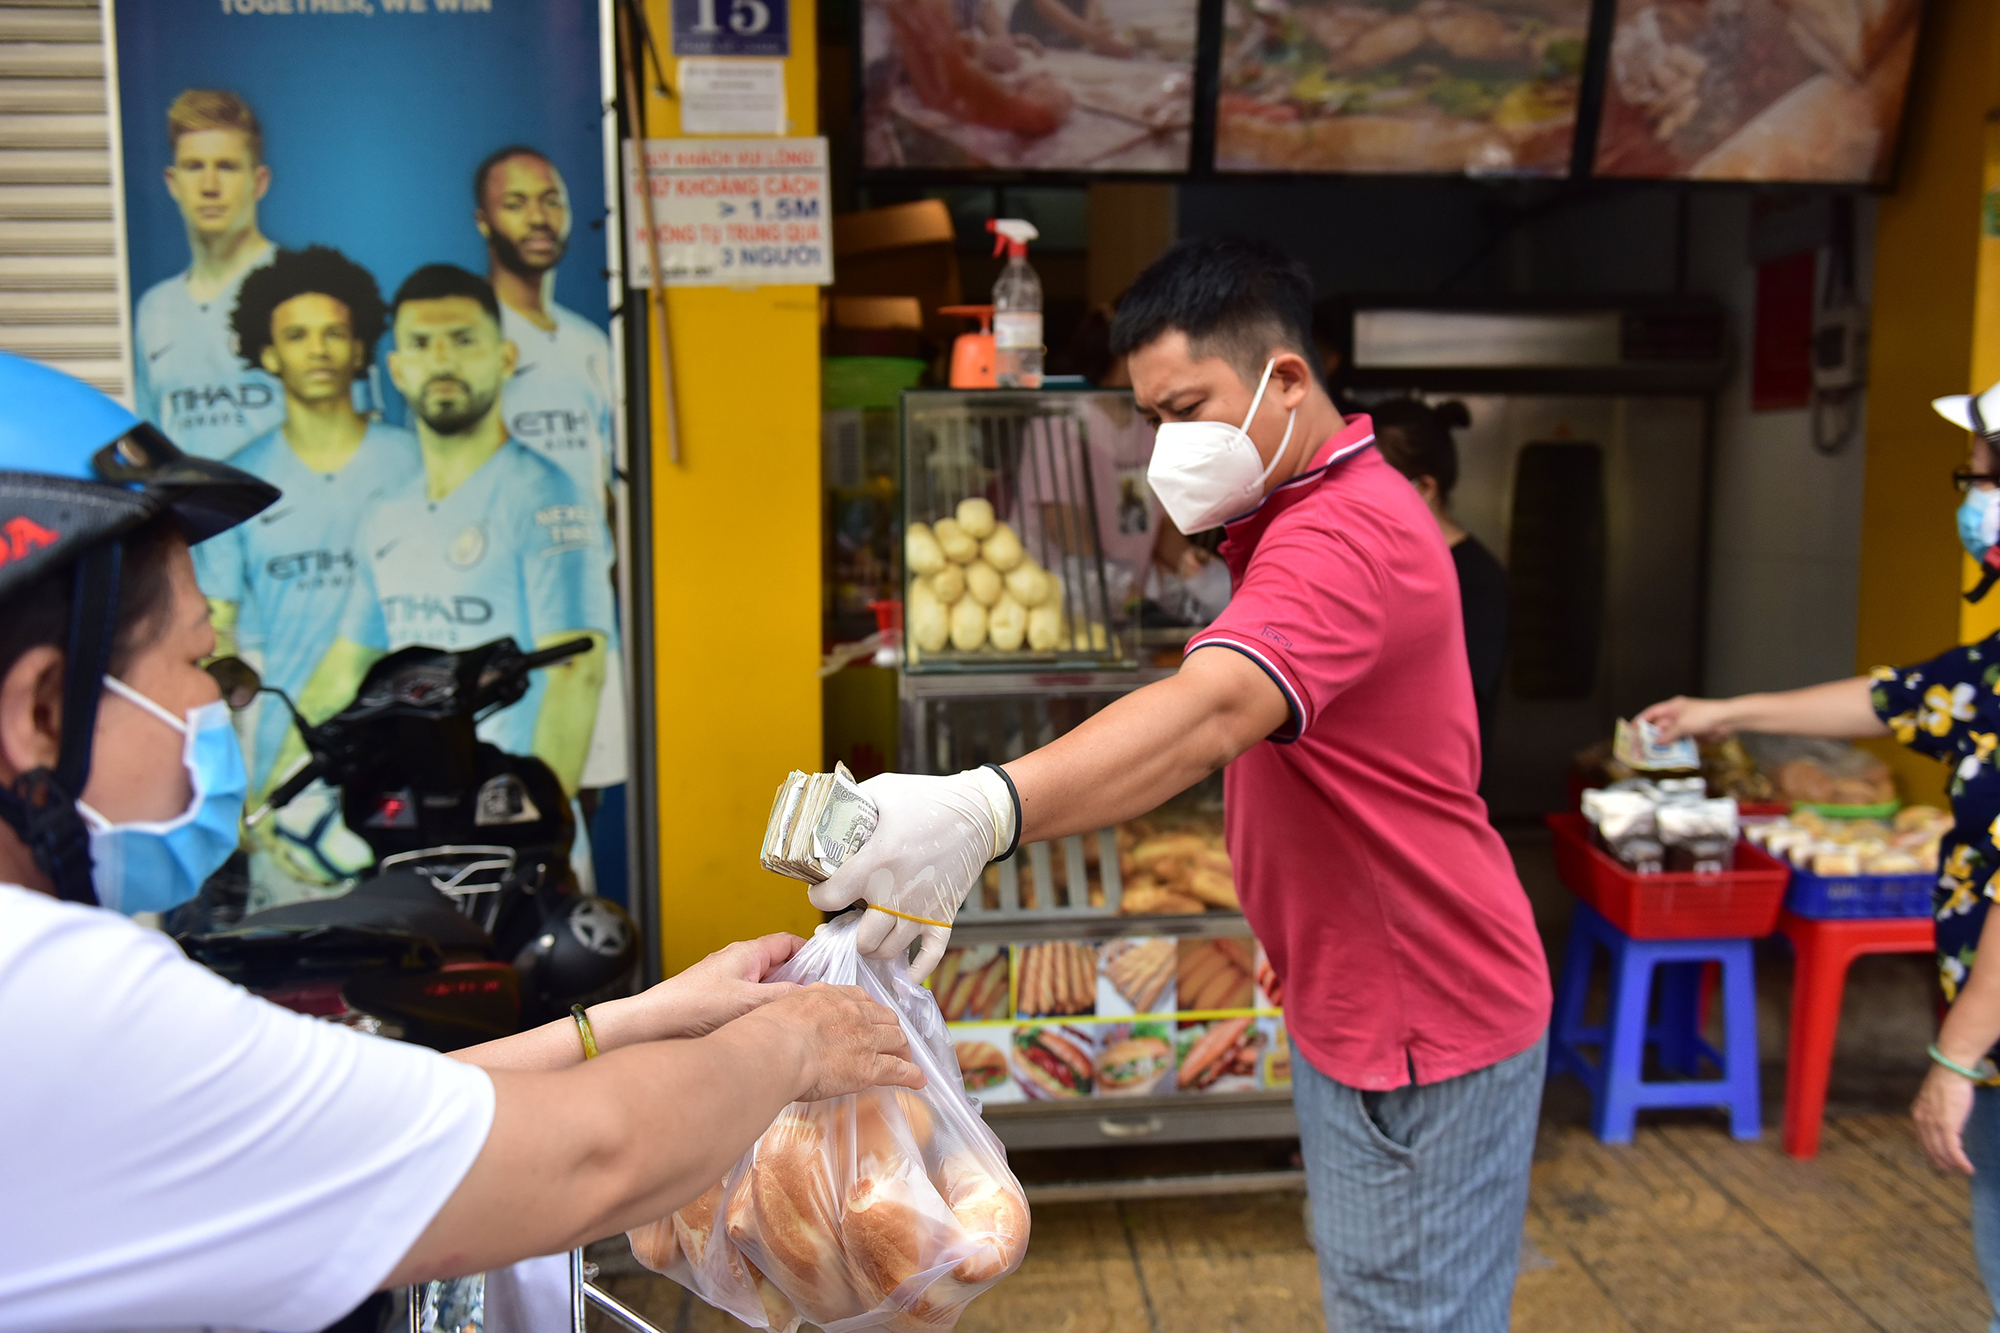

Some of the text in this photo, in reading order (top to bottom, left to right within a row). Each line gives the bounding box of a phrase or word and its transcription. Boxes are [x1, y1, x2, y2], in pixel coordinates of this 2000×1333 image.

[220, 0, 493, 17] TOGETHER, WE WIN
[690, 0, 771, 36] 15
